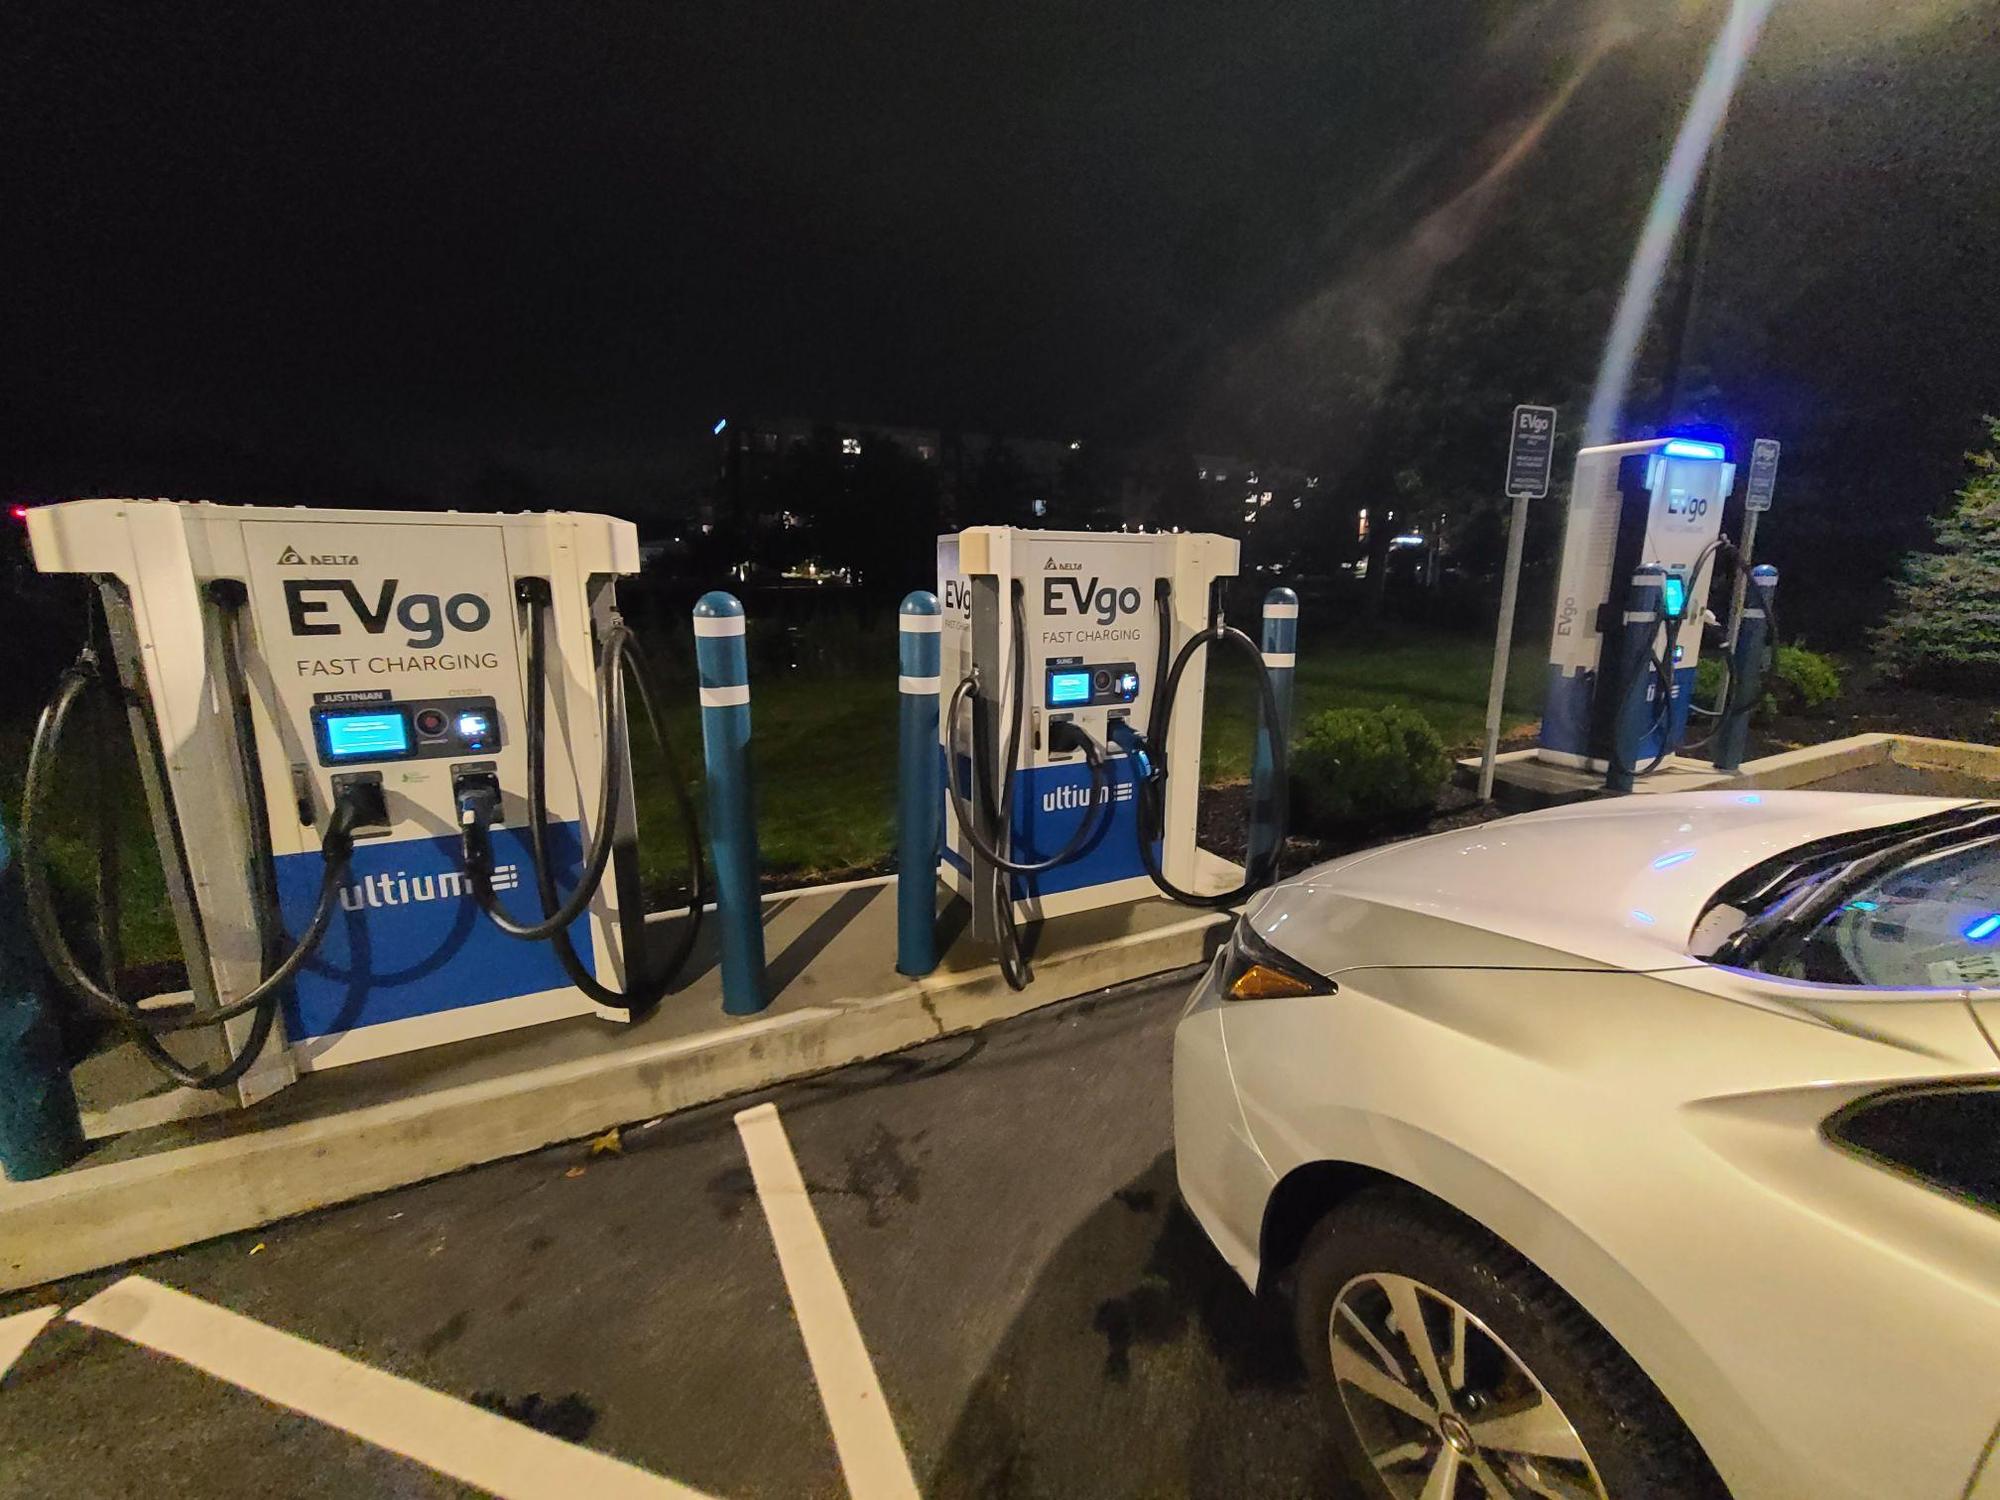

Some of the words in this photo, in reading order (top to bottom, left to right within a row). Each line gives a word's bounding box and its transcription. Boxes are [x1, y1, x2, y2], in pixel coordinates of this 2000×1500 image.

[1520, 414, 1549, 433] EVgo
[310, 555, 359, 566] DELTA
[282, 579, 491, 649] EVgo
[946, 580, 971, 619] EVg
[1043, 577, 1141, 626] EVgo
[1558, 597, 1578, 636] EVgo
[1043, 631, 1073, 644] FAST
[1076, 629, 1141, 643] CHARGING
[297, 658, 361, 676] FAST
[368, 652, 499, 674] CHARGING
[323, 693, 383, 703] JUSTINIAN
[340, 871, 474, 911] ultium
